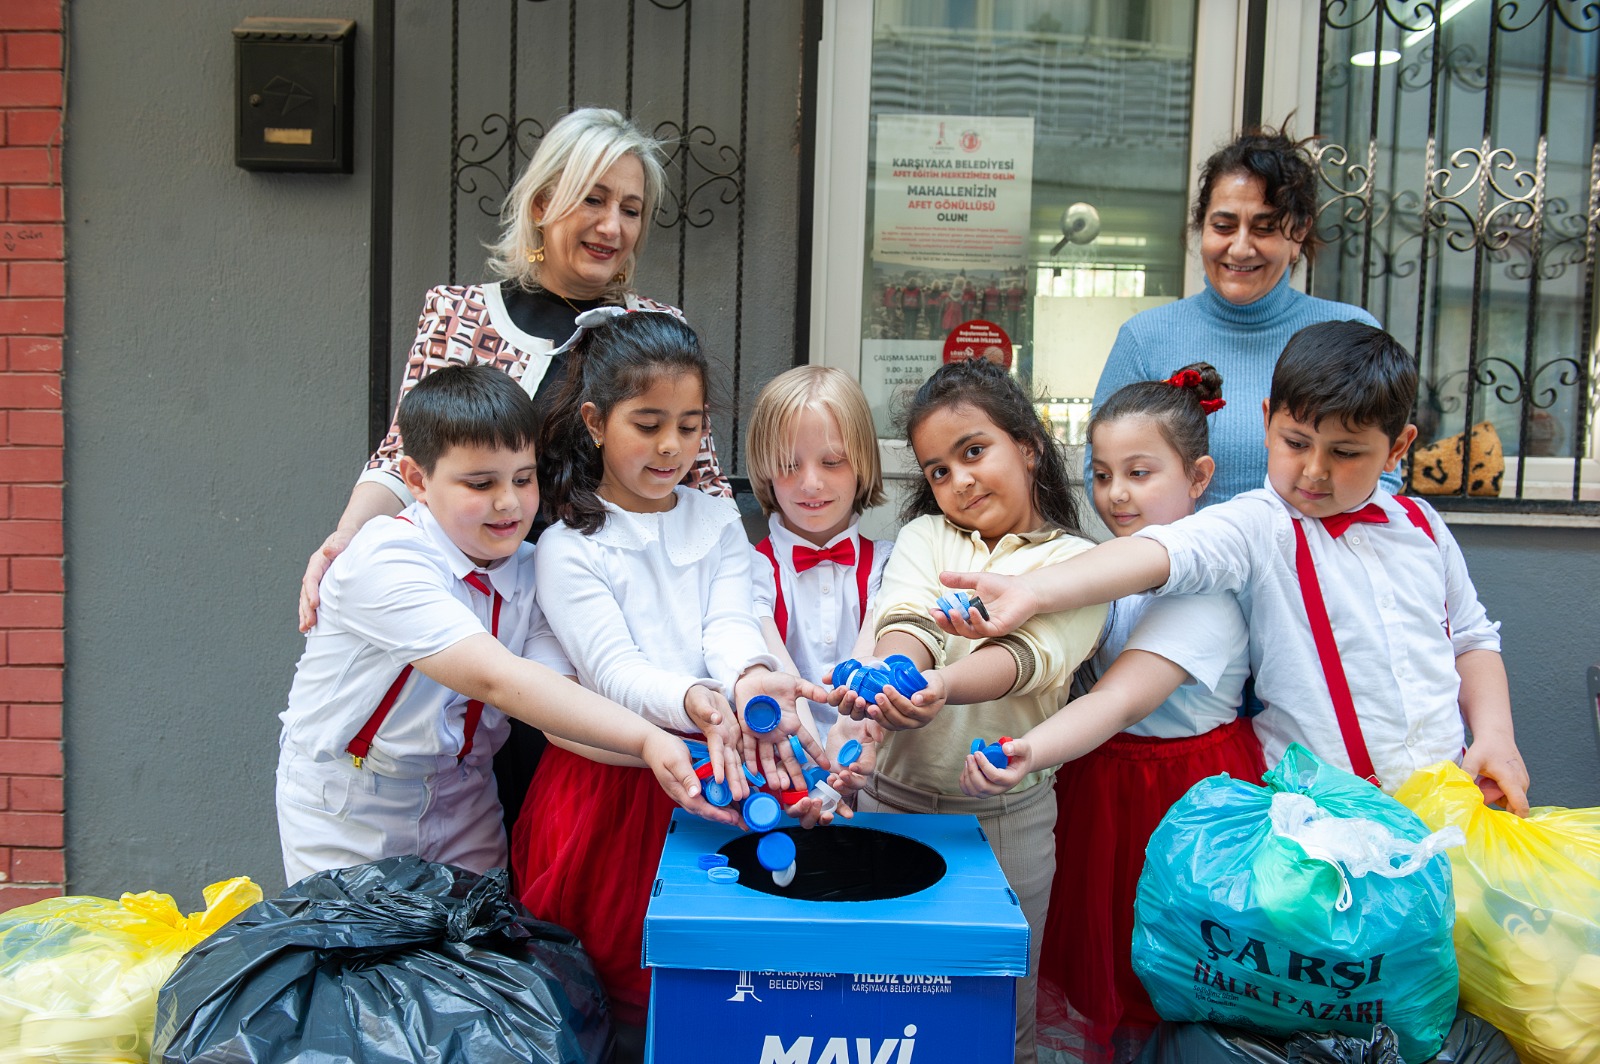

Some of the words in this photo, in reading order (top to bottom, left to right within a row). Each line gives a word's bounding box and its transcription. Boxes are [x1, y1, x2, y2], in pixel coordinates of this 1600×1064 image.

[892, 158, 953, 170] KARŞIYAKA
[955, 158, 1014, 170] BELEDİYESİ
[913, 170, 939, 178] EĞİTİM
[941, 171, 991, 180] MERKEZİMİZE
[992, 172, 1015, 180] GELİN
[907, 184, 997, 198] MAHALLENİZİN
[908, 200, 932, 209] AFET
[934, 199, 995, 211] GÖNÜLLÜSÜ
[937, 213, 968, 222] OLUN!
[874, 354, 904, 362] ÇALIŞMA
[1200, 919, 1386, 998] ÇARŞI
[1193, 957, 1260, 1000] HALK
[768, 979, 824, 991] BELEDİYESİ
[851, 984, 888, 994] KARŞIYAKA
[889, 983, 921, 993] BELEDİYE
[922, 985, 952, 995] BAŞKANI
[758, 1024, 918, 1064] MAVİ
